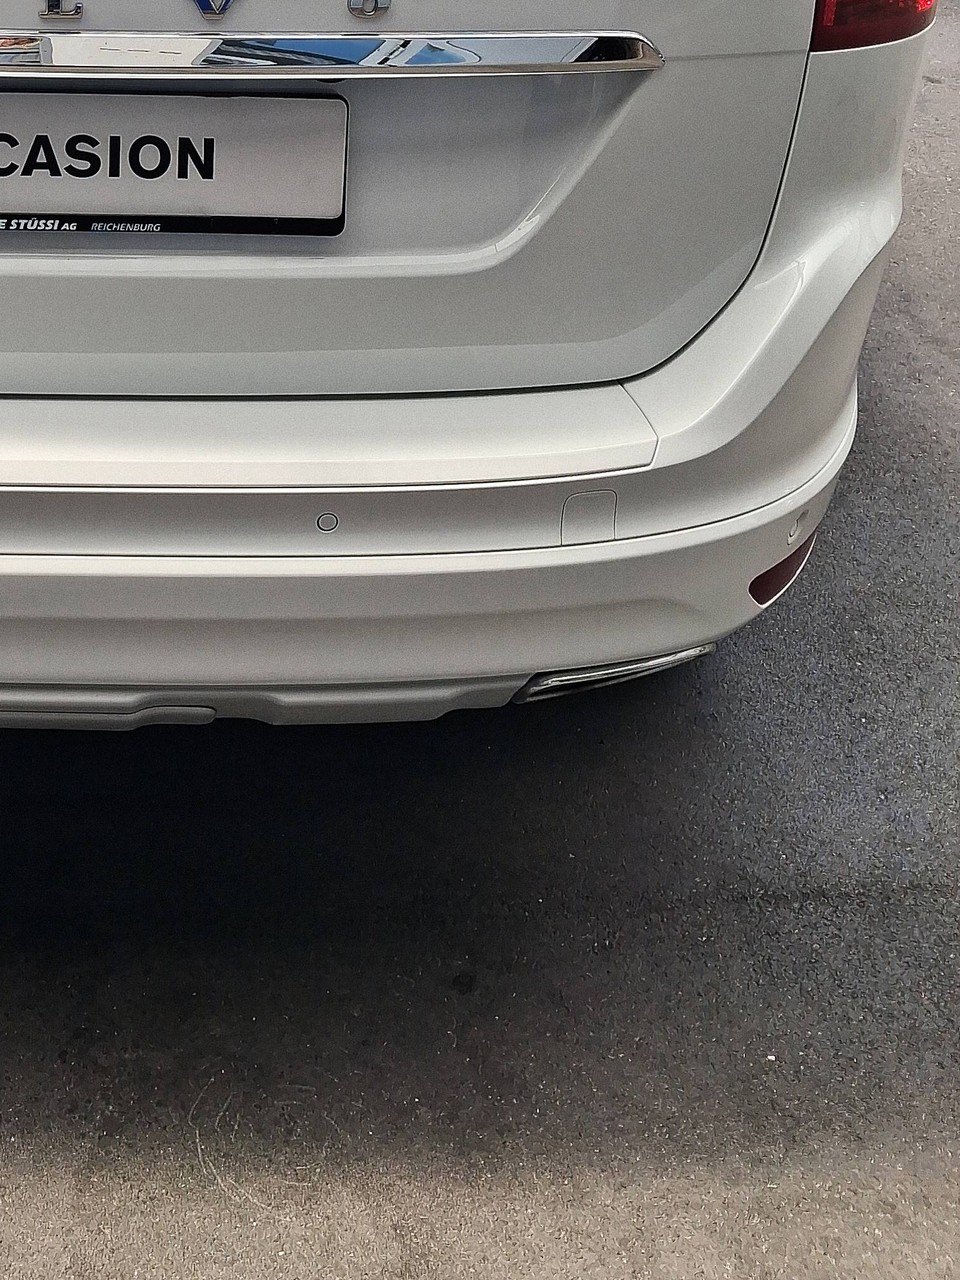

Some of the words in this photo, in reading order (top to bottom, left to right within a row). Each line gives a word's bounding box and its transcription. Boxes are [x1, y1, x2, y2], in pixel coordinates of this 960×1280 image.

[8, 217, 60, 231] STÜSSI
[61, 222, 78, 232] AG
[91, 222, 162, 233] REICHENBURG
